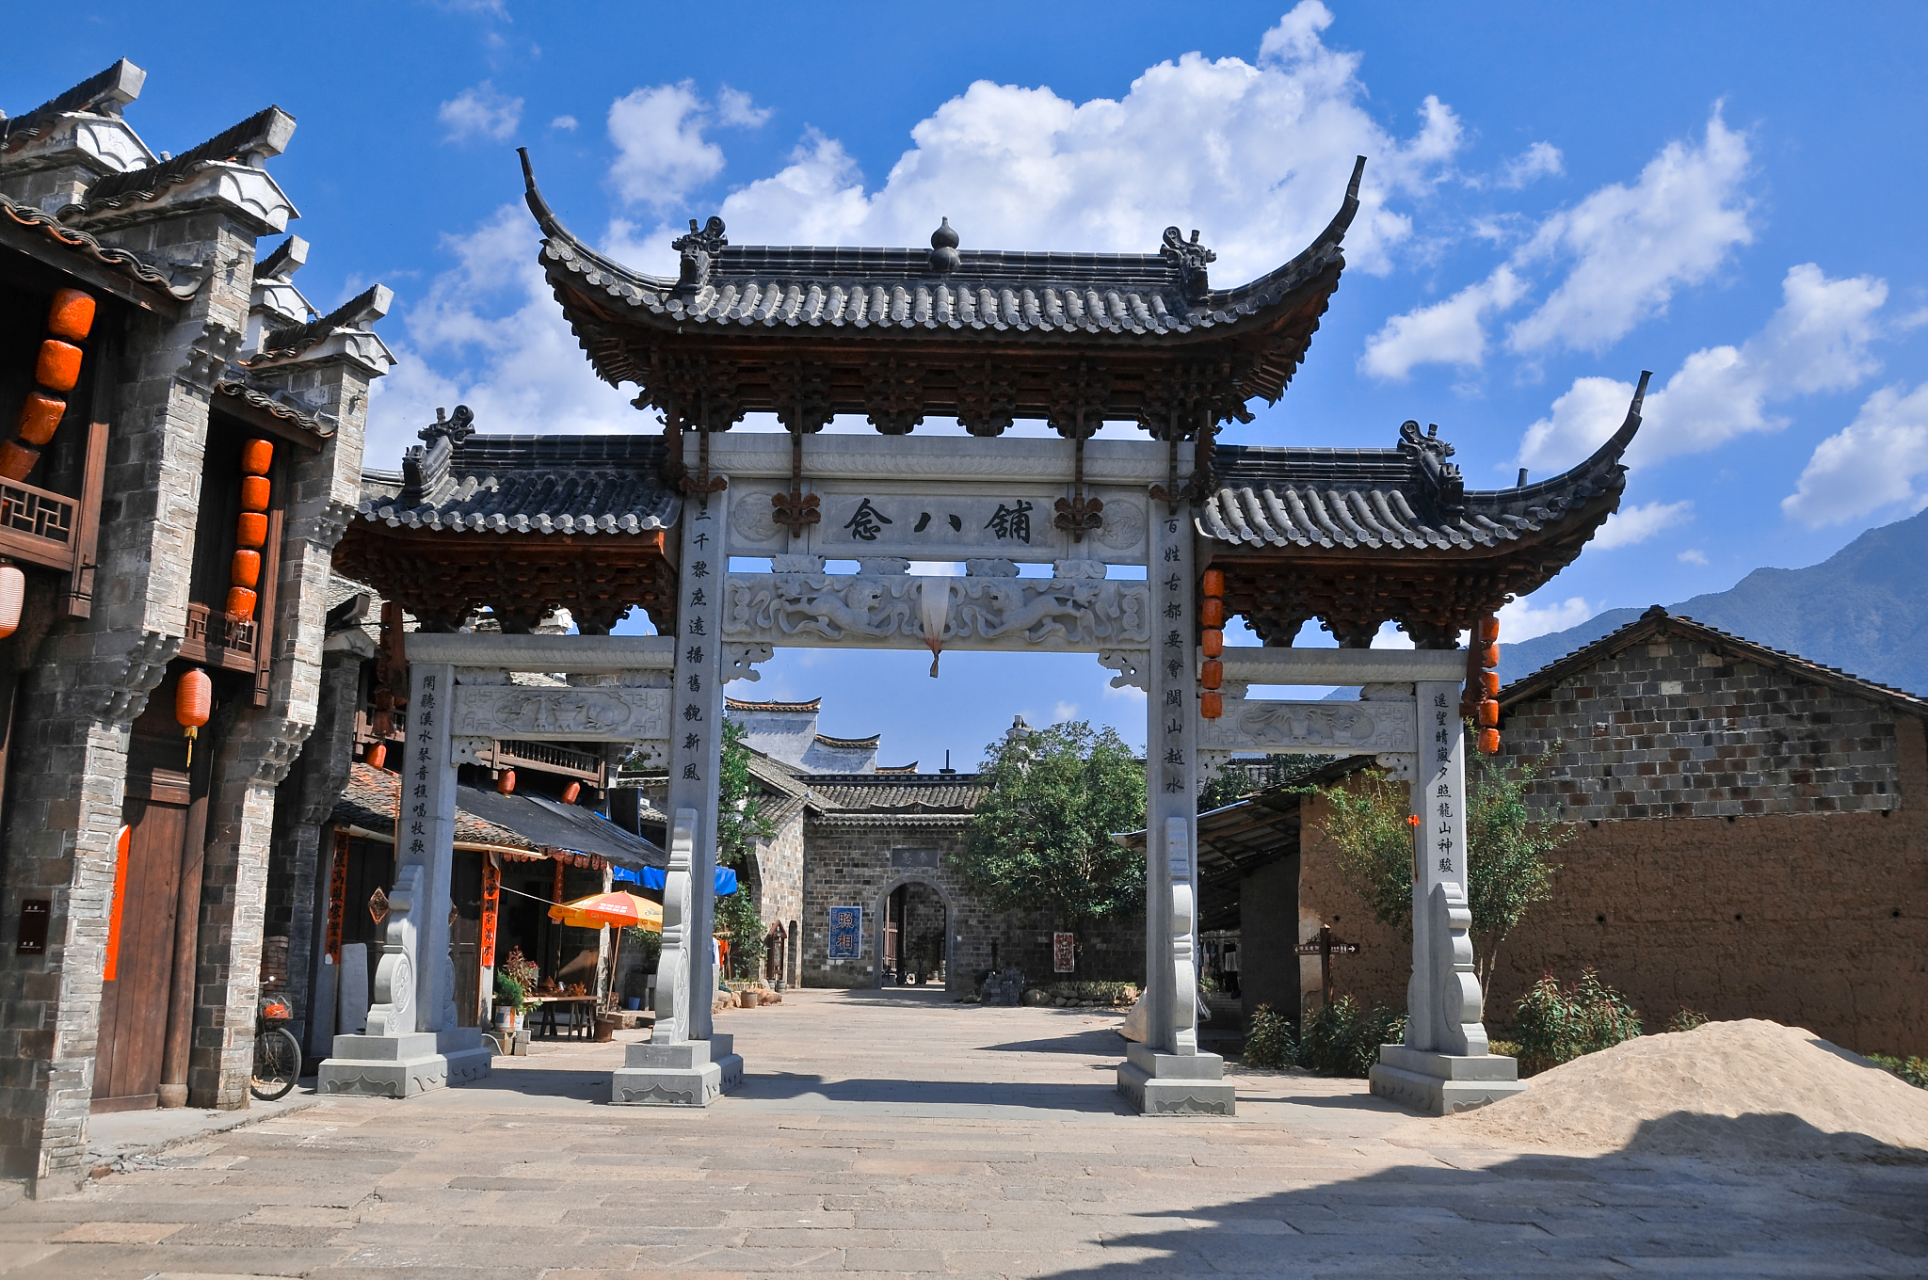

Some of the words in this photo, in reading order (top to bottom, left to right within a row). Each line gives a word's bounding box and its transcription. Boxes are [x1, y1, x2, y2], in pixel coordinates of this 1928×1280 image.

[843, 497, 1034, 545] 念八舖
[1163, 518, 1186, 794] 百姓古都要會閩山越水
[836, 911, 854, 950] 照相
